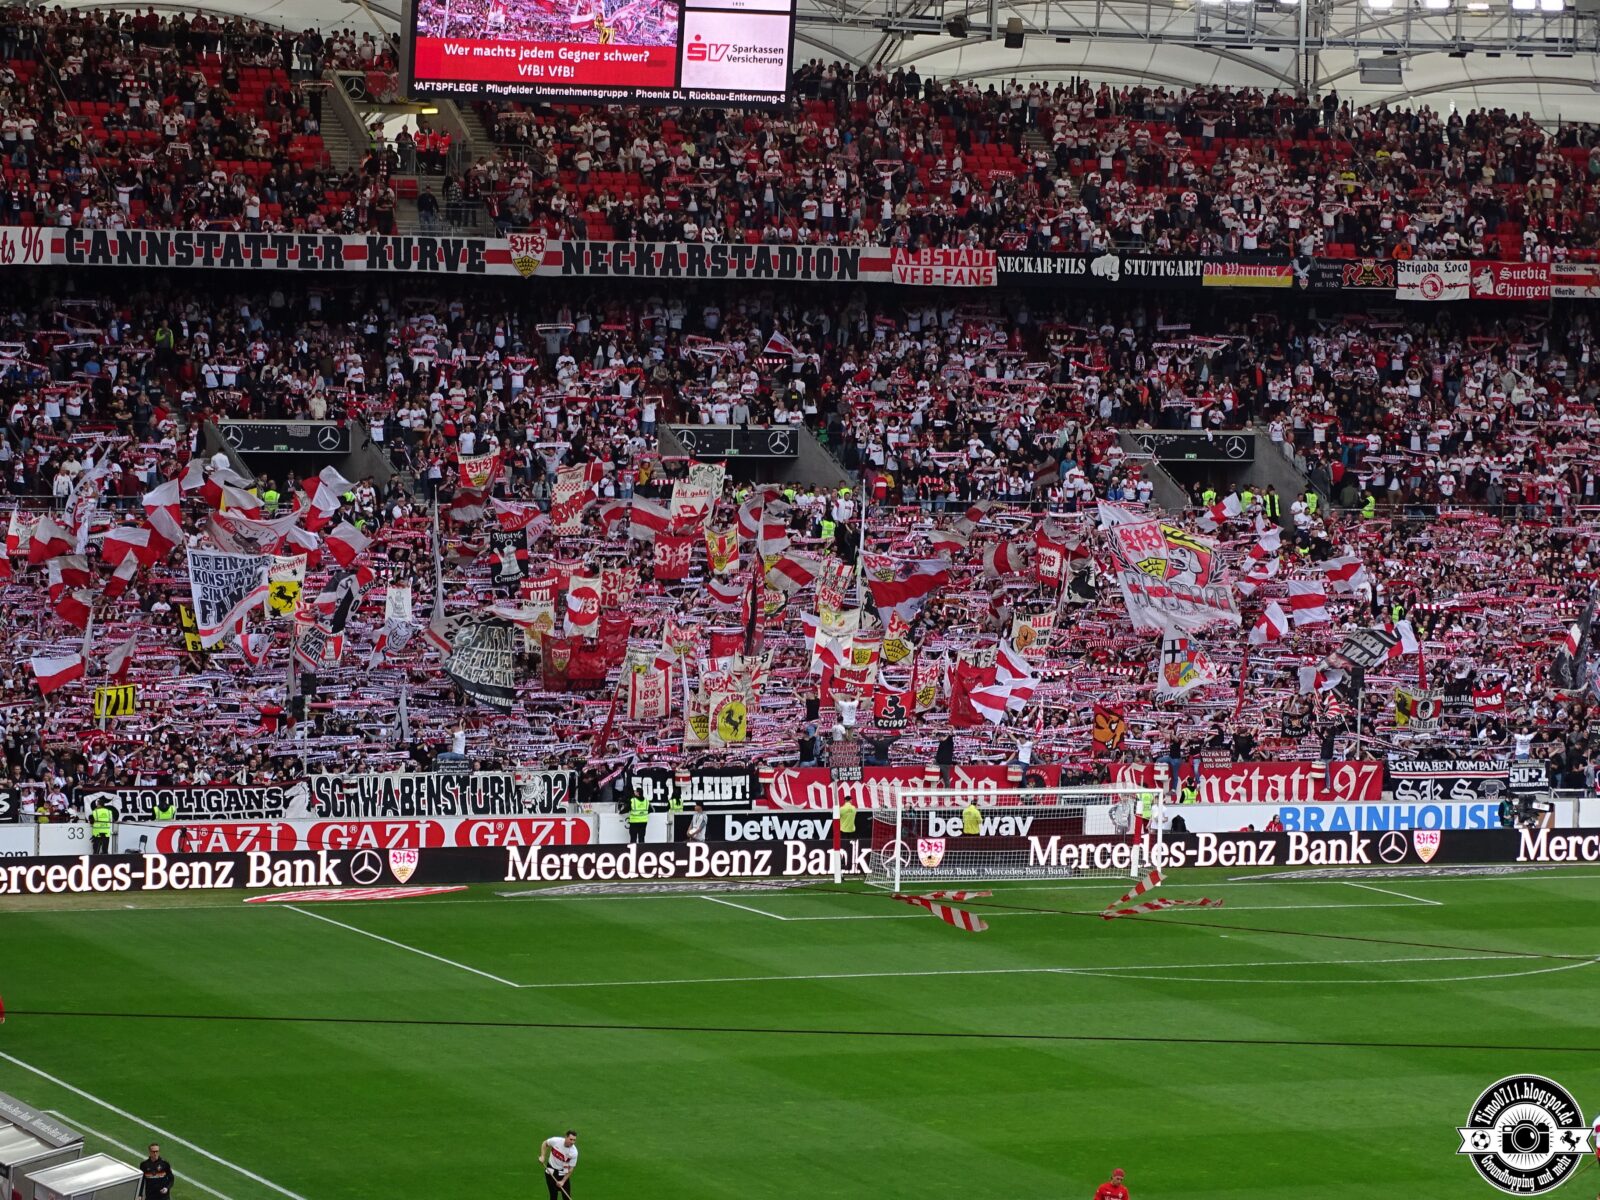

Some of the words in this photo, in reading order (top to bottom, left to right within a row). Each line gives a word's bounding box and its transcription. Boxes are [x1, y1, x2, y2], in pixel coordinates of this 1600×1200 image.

[444, 43, 470, 56] Wer
[473, 45, 517, 58] machts
[519, 46, 555, 60] jedem
[558, 49, 600, 65] Gegner
[603, 49, 650, 63] schwer?
[726, 54, 784, 67] Versicherung
[732, 44, 785, 55] Sparkassen
[517, 63, 545, 77] VfB!
[548, 65, 575, 78] VfB!
[486, 83, 534, 95] Pflugfelder
[535, 85, 629, 99] Unternehmensgruppe
[635, 89, 671, 99] Phoenix
[672, 90, 687, 101] DL,
[21, 225, 44, 264] 96
[64, 229, 346, 271] CANNSTATTER
[365, 238, 488, 274] KURVE
[561, 241, 862, 281] NECKARSTADION
[894, 248, 996, 267] ALBSTADT
[997, 255, 1086, 275] NECKAR-FILS
[1124, 258, 1204, 278] STUTTGART
[1397, 262, 1439, 275] Brigada
[1444, 261, 1468, 273] Loca
[897, 267, 994, 286] VFB-FANS
[1203, 261, 1223, 277] Old
[1226, 262, 1278, 280] Warriors
[1499, 267, 1548, 280] Suebia
[1495, 283, 1550, 299] Ehingen
[1031, 617, 1052, 628] ALLE
[94, 687, 134, 716] 0711
[639, 688, 662, 701] 1893
[877, 718, 908, 728] CC1997
[1388, 760, 1454, 772] SCHWABEN
[1455, 760, 1510, 771] KOMPANIE
[1509, 767, 1549, 783] 50+1
[540, 772, 569, 815] 02
[681, 776, 751, 800] BLEIBT!
[769, 767, 998, 809] Commando
[1332, 764, 1381, 801] 97
[116, 788, 284, 814] HOOLIGANS
[724, 815, 834, 841] betway
[928, 811, 1034, 838] beway
[1279, 804, 1501, 832] BRAINHOUSE
[67, 827, 85, 840] 33
[1029, 832, 1276, 871] Mercedes-Benz
[1286, 830, 1371, 865] Bank
[1515, 828, 1600, 862] Merc
[504, 840, 773, 882] Mercedes-Benz
[783, 838, 872, 876] Bank
[0, 853, 235, 895] ercedes-Benz
[246, 850, 343, 888] Bank
